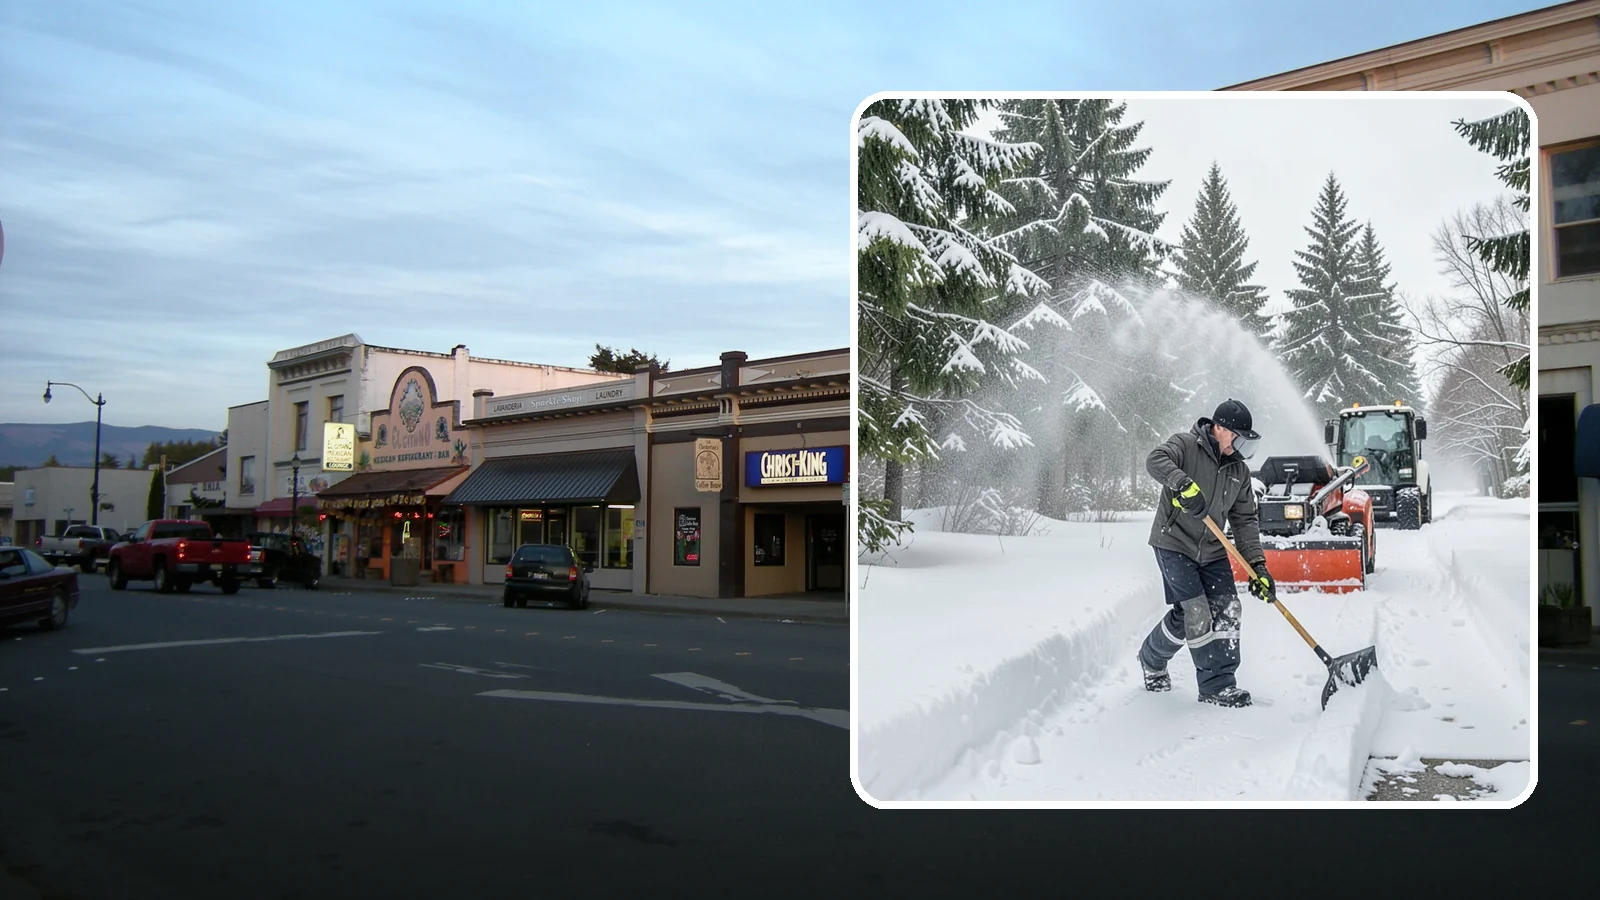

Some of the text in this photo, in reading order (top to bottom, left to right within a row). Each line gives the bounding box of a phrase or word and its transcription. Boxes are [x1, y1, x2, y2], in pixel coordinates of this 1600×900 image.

[530, 394, 583, 409] Sparkle Shop
[595, 388, 624, 400] LAUNDRY
[493, 401, 523, 413] LAVANDERIA
[373, 454, 396, 464] MEXICAN
[397, 451, 433, 463] RESTAURANT
[437, 449, 450, 459] BAR
[761, 450, 828, 478] CHRIST KING
